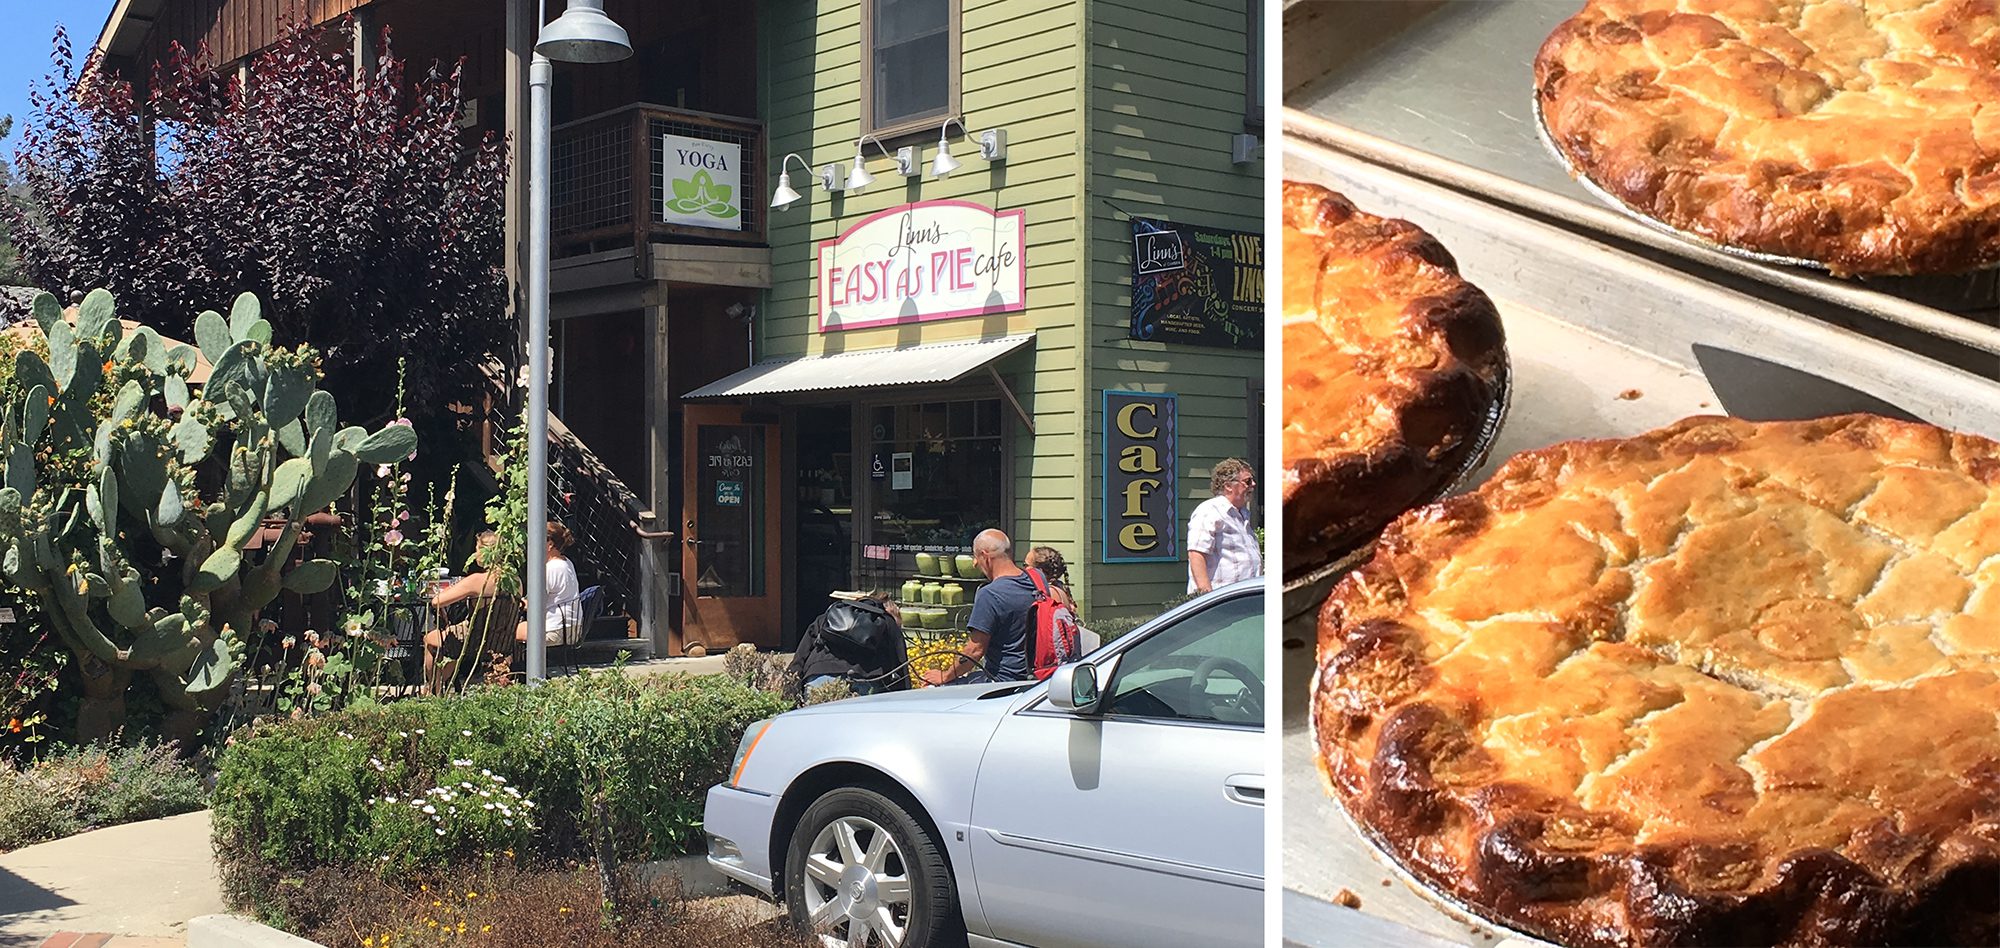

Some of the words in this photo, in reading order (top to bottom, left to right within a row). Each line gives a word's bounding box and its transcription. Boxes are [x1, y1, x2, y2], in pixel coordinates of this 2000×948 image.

[676, 148, 728, 171] YOGA
[888, 213, 948, 257] Linn's
[1195, 232, 1231, 246] Saturdays
[1231, 234, 1262, 266] LIVE
[1141, 236, 1179, 269] Linn's
[828, 259, 892, 306] EASY
[896, 266, 922, 298] AS
[931, 247, 975, 293] PIE
[1116, 402, 1163, 552] Cafe
[718, 495, 740, 504] OPEN
